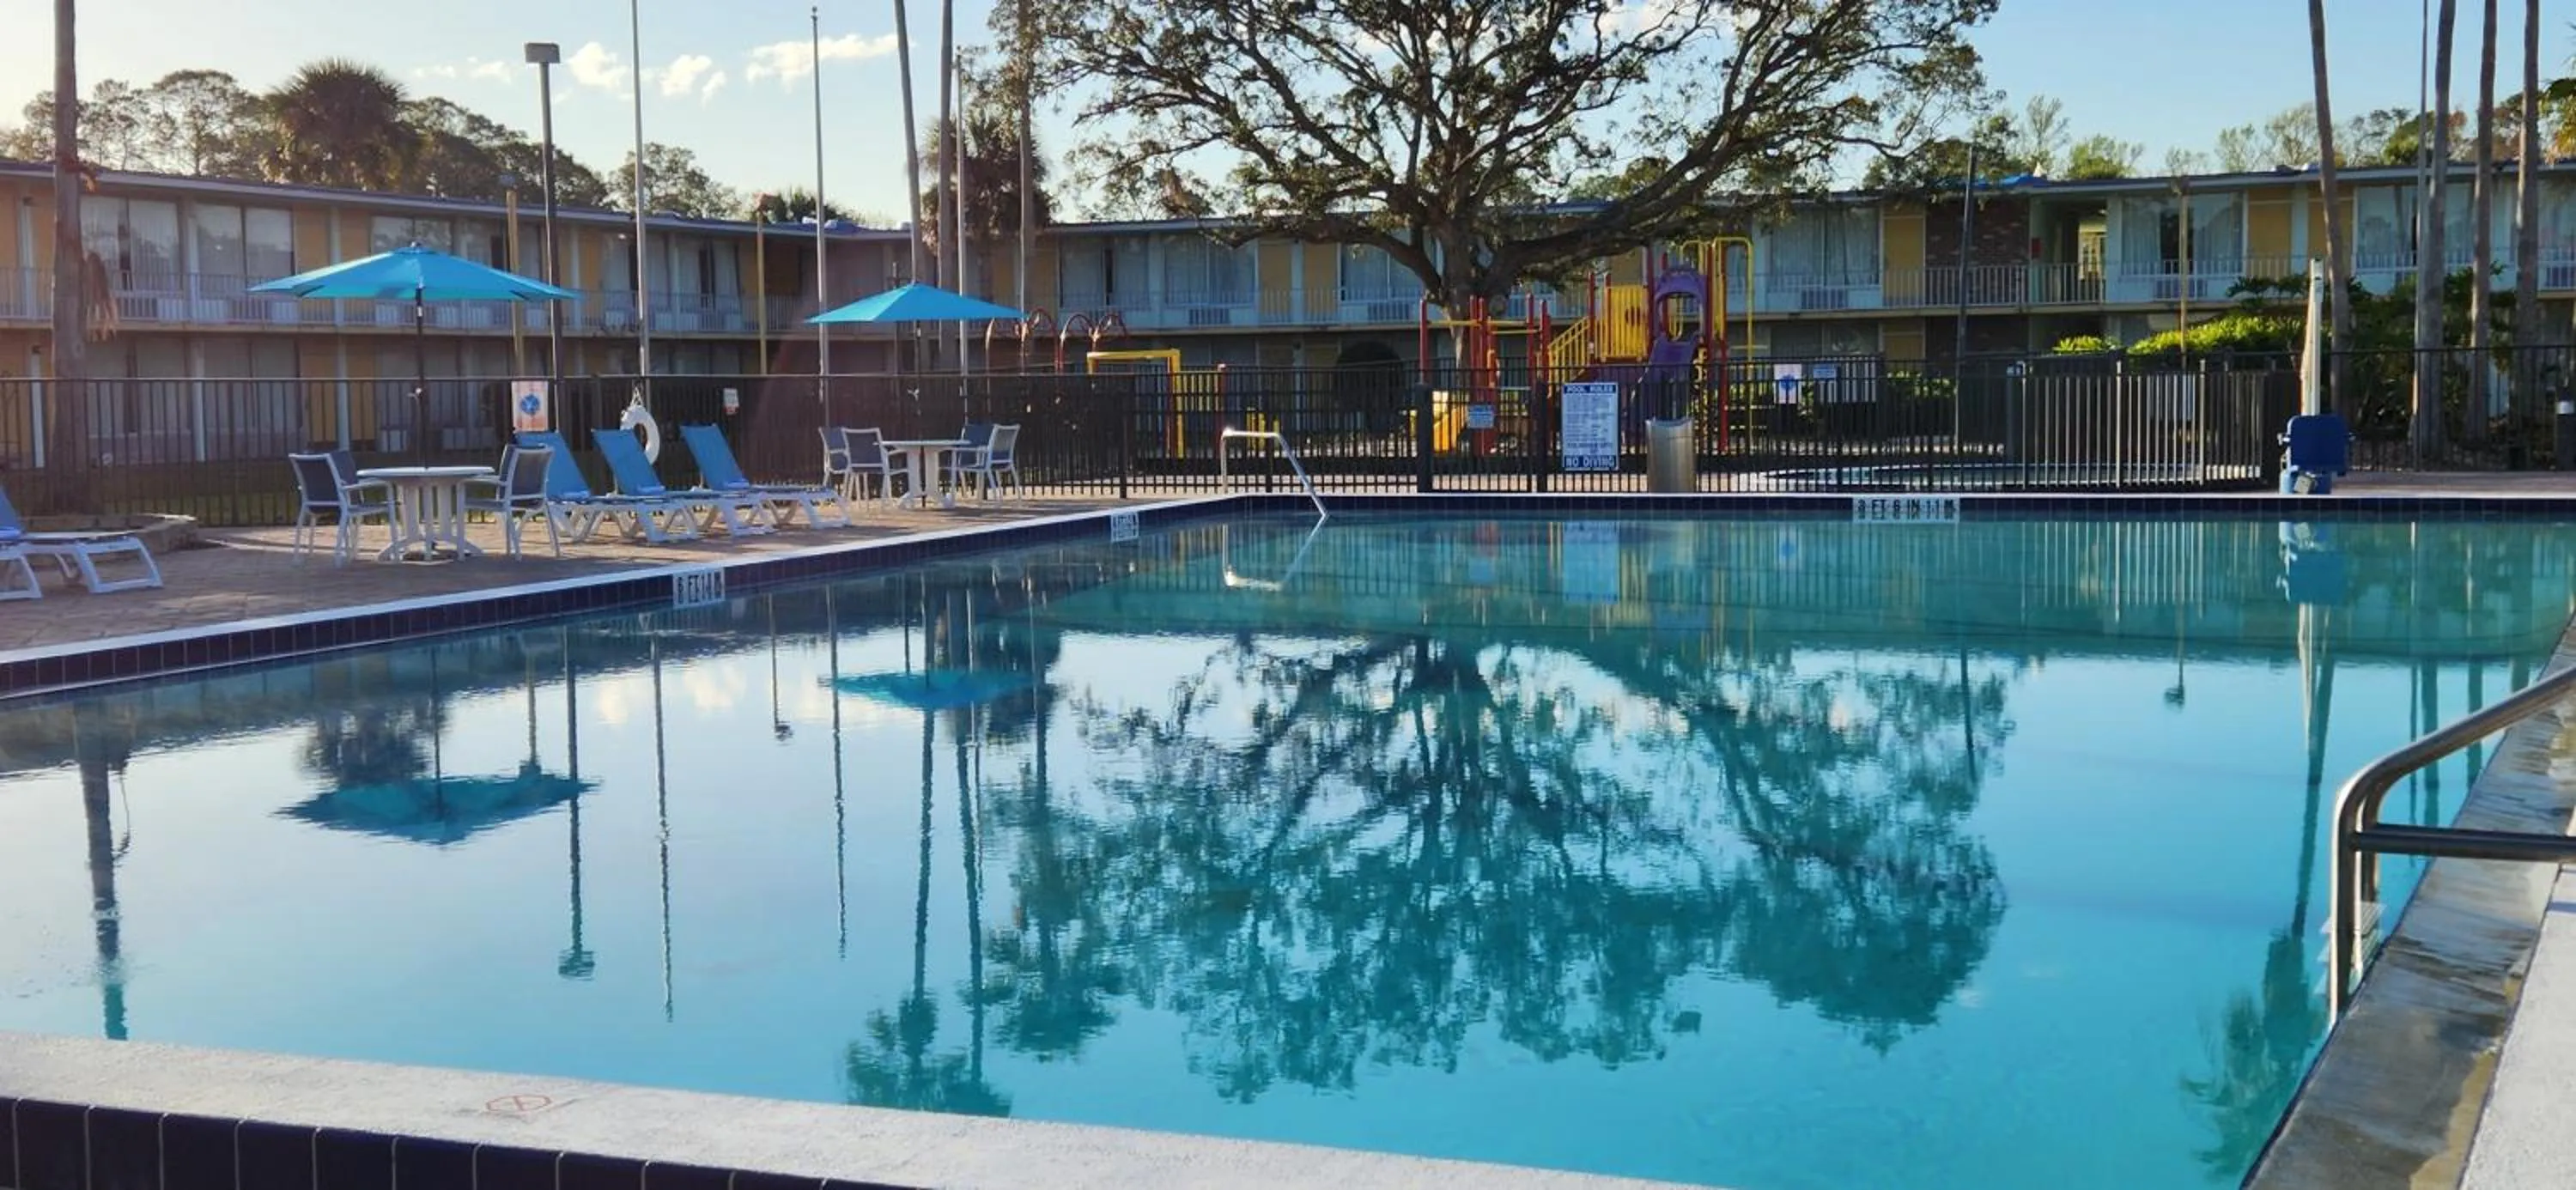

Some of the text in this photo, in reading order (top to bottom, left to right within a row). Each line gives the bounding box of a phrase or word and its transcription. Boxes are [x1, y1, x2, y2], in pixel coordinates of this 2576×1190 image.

[1565, 456, 1615, 468] NO DIVING
[1872, 499, 1886, 516] FT
